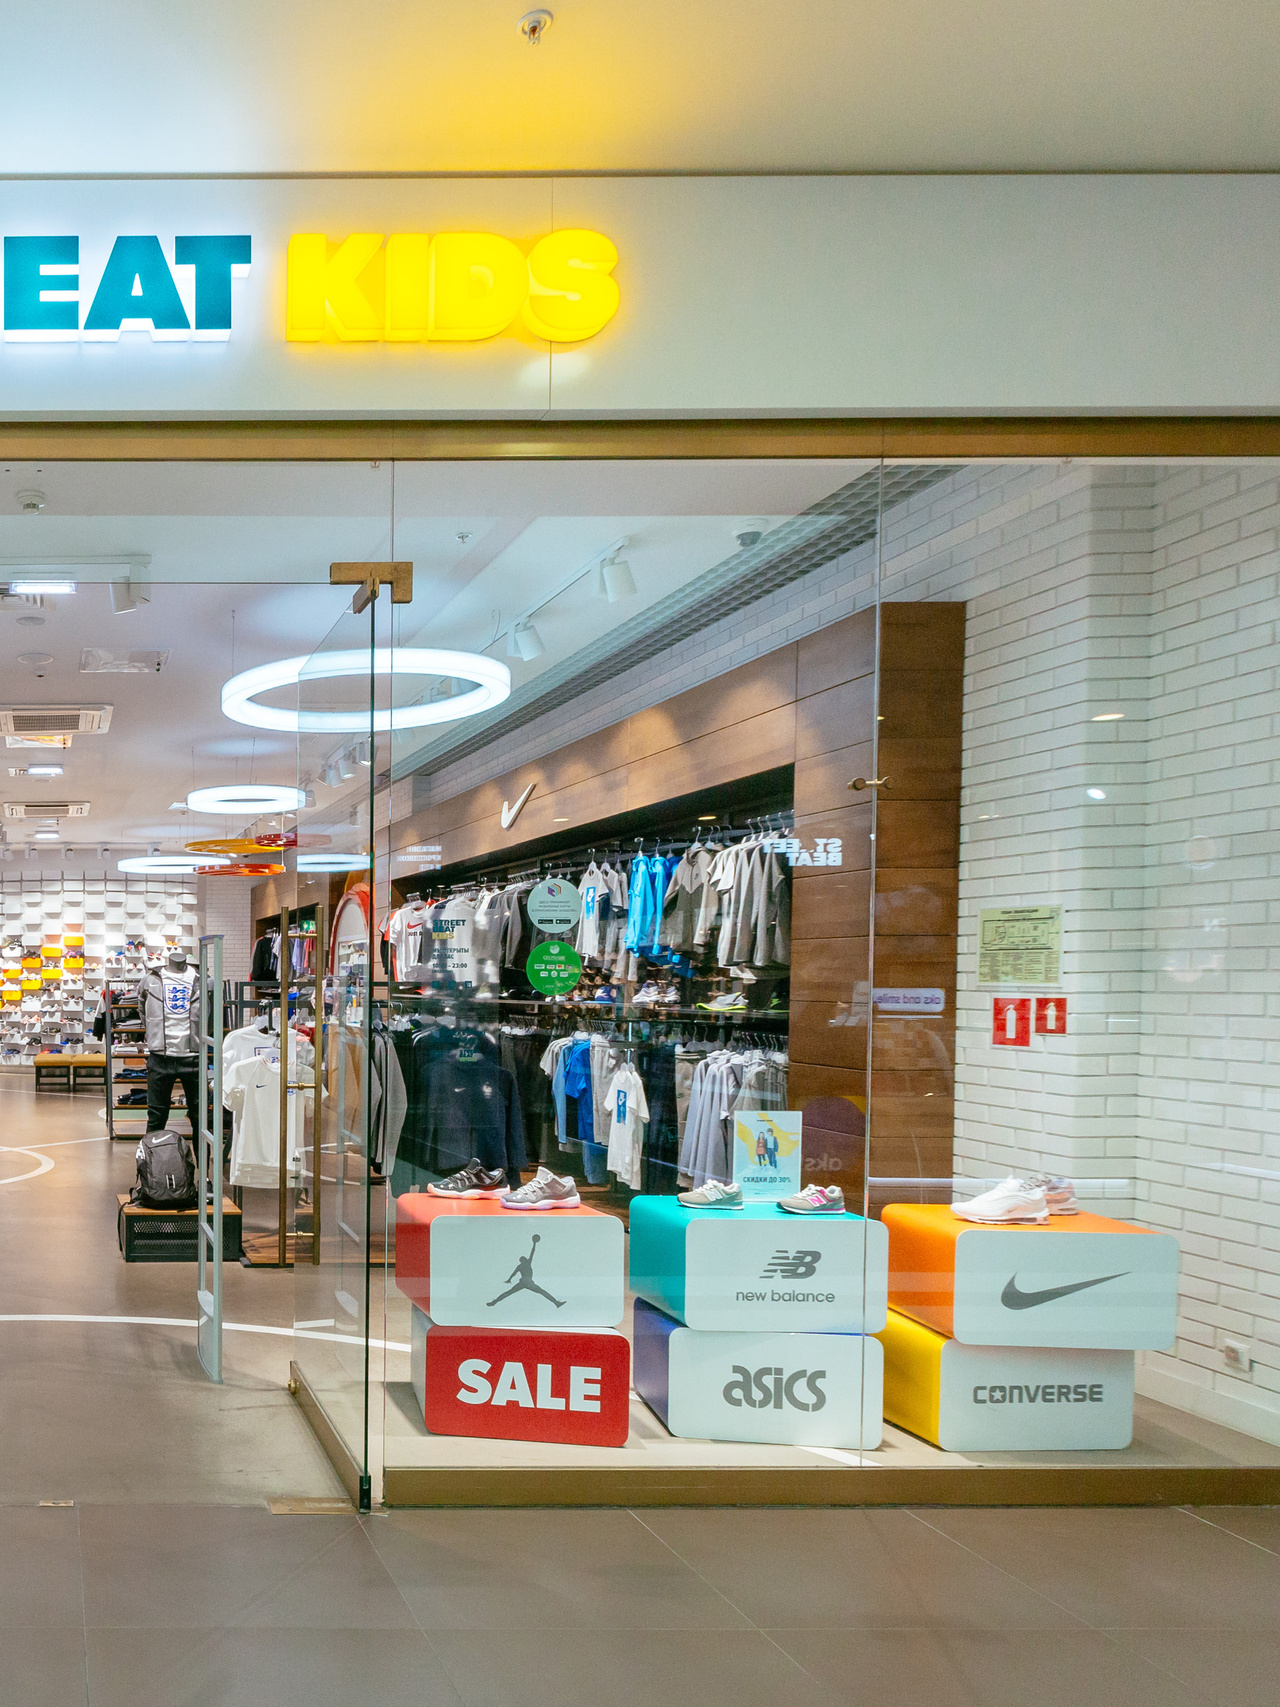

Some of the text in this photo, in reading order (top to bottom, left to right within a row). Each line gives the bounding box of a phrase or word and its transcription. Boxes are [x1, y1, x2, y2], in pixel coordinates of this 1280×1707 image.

[286, 229, 620, 343] KIDS
[742, 1176, 768, 1184] СКИДКИ
[769, 1176, 778, 1184] ДО
[735, 1289, 835, 1303] new balance
[455, 1358, 602, 1414] SALE
[722, 1364, 827, 1413] asics
[972, 1383, 1104, 1405] CONVERSE
